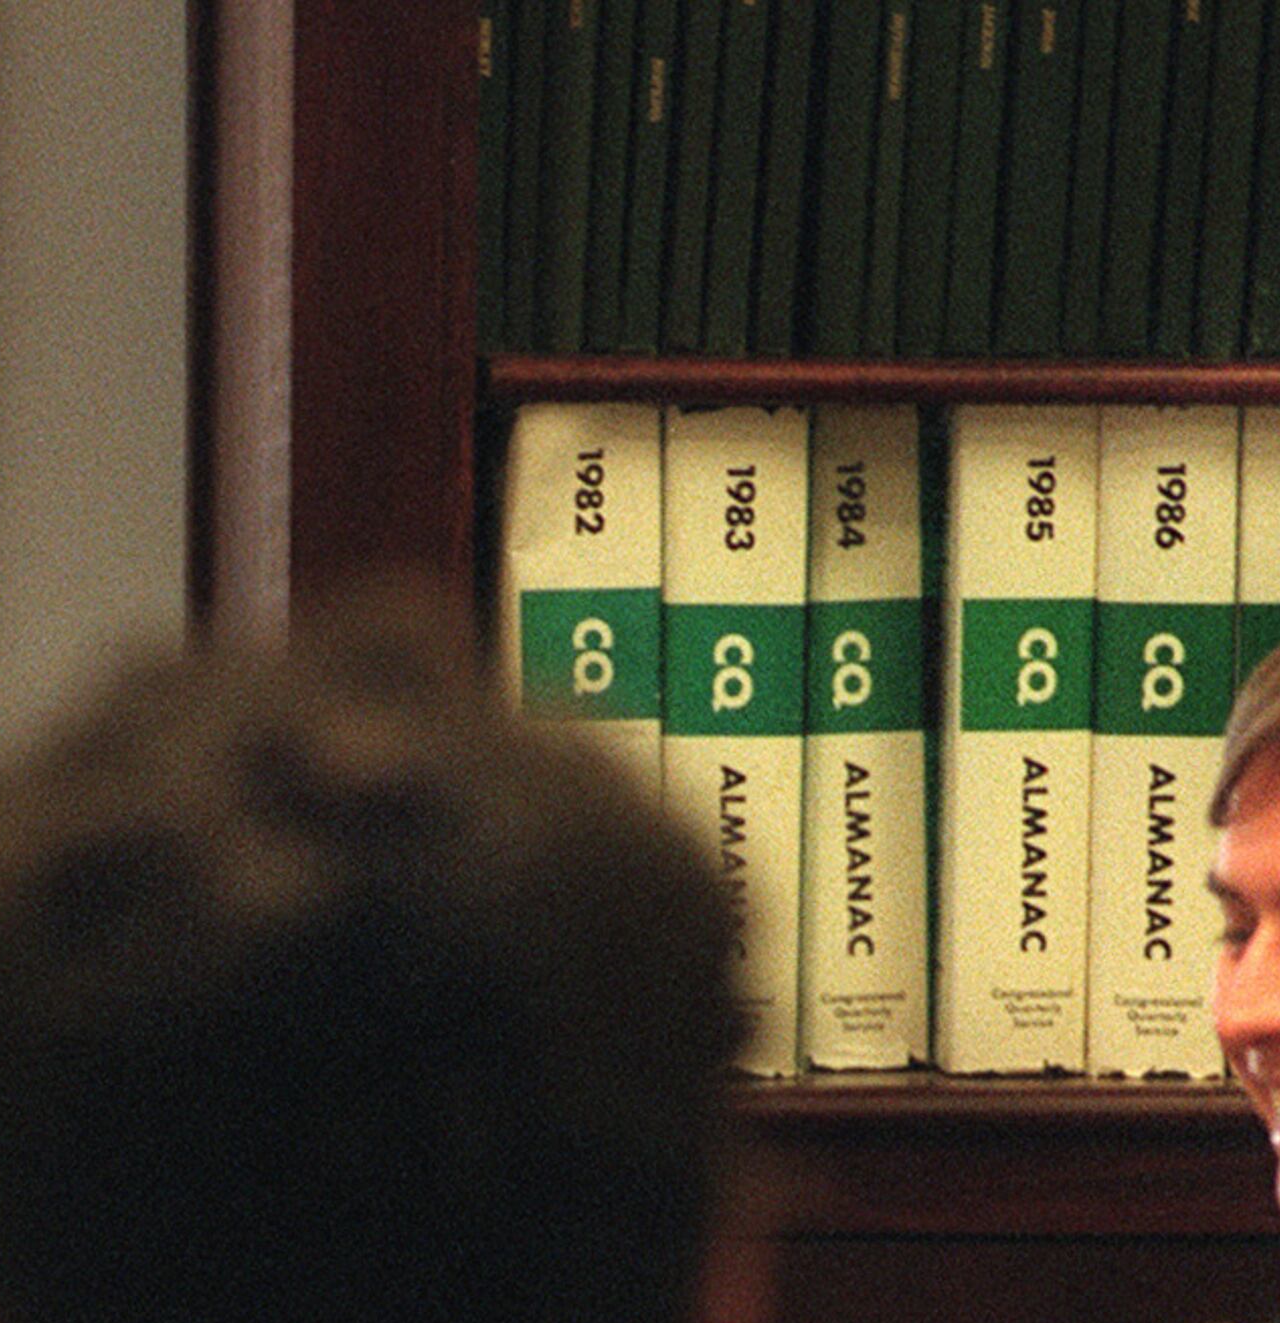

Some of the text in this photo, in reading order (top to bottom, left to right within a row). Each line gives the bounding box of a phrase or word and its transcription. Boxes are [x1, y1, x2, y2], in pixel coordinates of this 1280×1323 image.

[575, 448, 605, 536] 1982
[725, 465, 756, 552] 1983
[837, 462, 867, 550] 1984
[1026, 456, 1057, 542] 1985
[1155, 463, 1187, 550] 1986
[572, 618, 614, 696] CQ
[713, 633, 754, 713] CQ
[832, 630, 872, 711] CQ
[1017, 627, 1058, 707] CQ
[1142, 633, 1184, 712] CQ
[844, 761, 875, 957] ALMANAC
[1020, 757, 1049, 953] ALMANAC
[1143, 764, 1176, 962] ALMANAC
